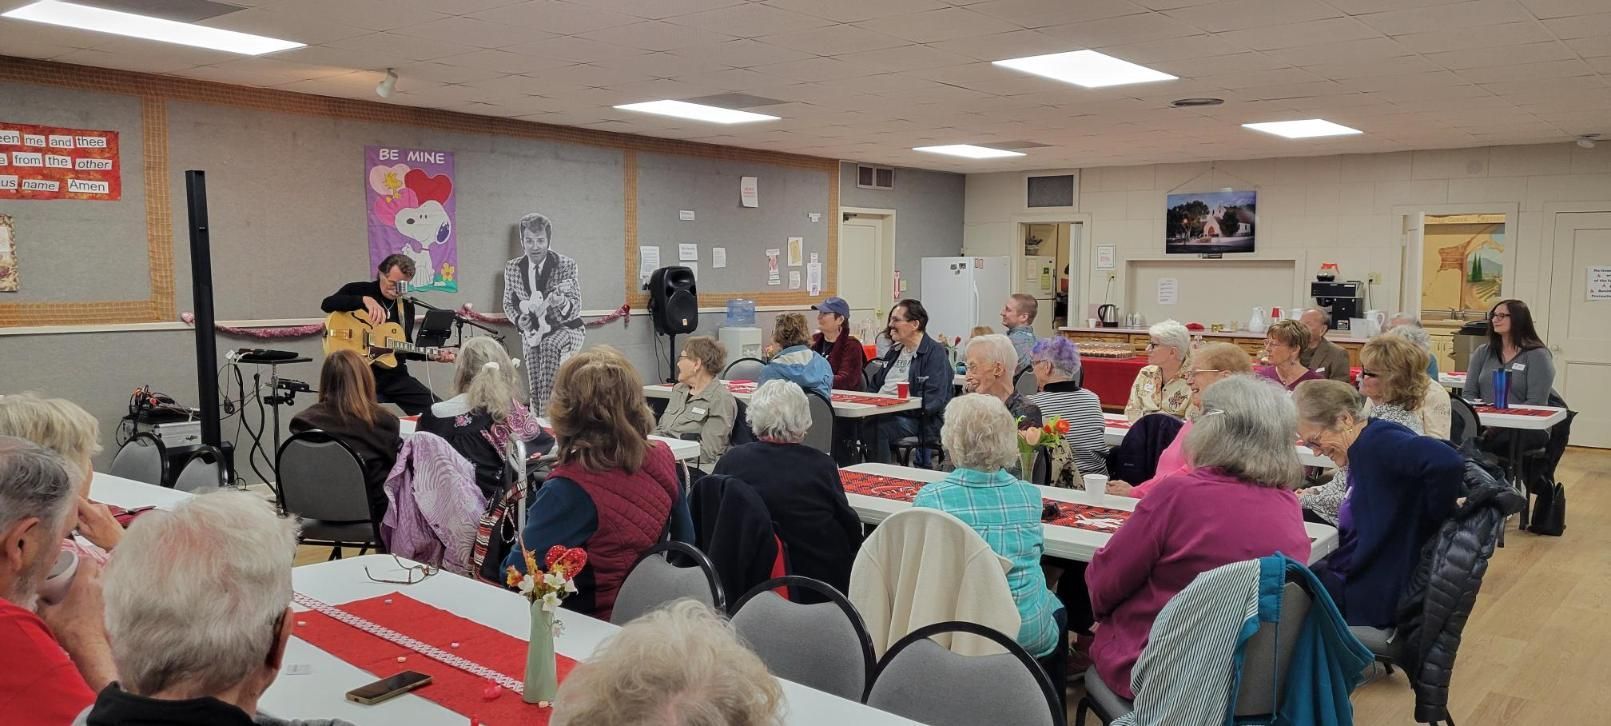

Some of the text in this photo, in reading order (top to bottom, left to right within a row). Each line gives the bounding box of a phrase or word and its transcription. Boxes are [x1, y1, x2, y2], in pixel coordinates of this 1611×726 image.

[25, 136, 43, 146] me
[51, 137, 72, 147] and
[77, 136, 104, 147] thee
[14, 154, 41, 165] from
[48, 156, 68, 166] the
[77, 159, 109, 169] other
[379, 148, 445, 164] BE MINE
[1, 179, 105, 192] us name Amen
